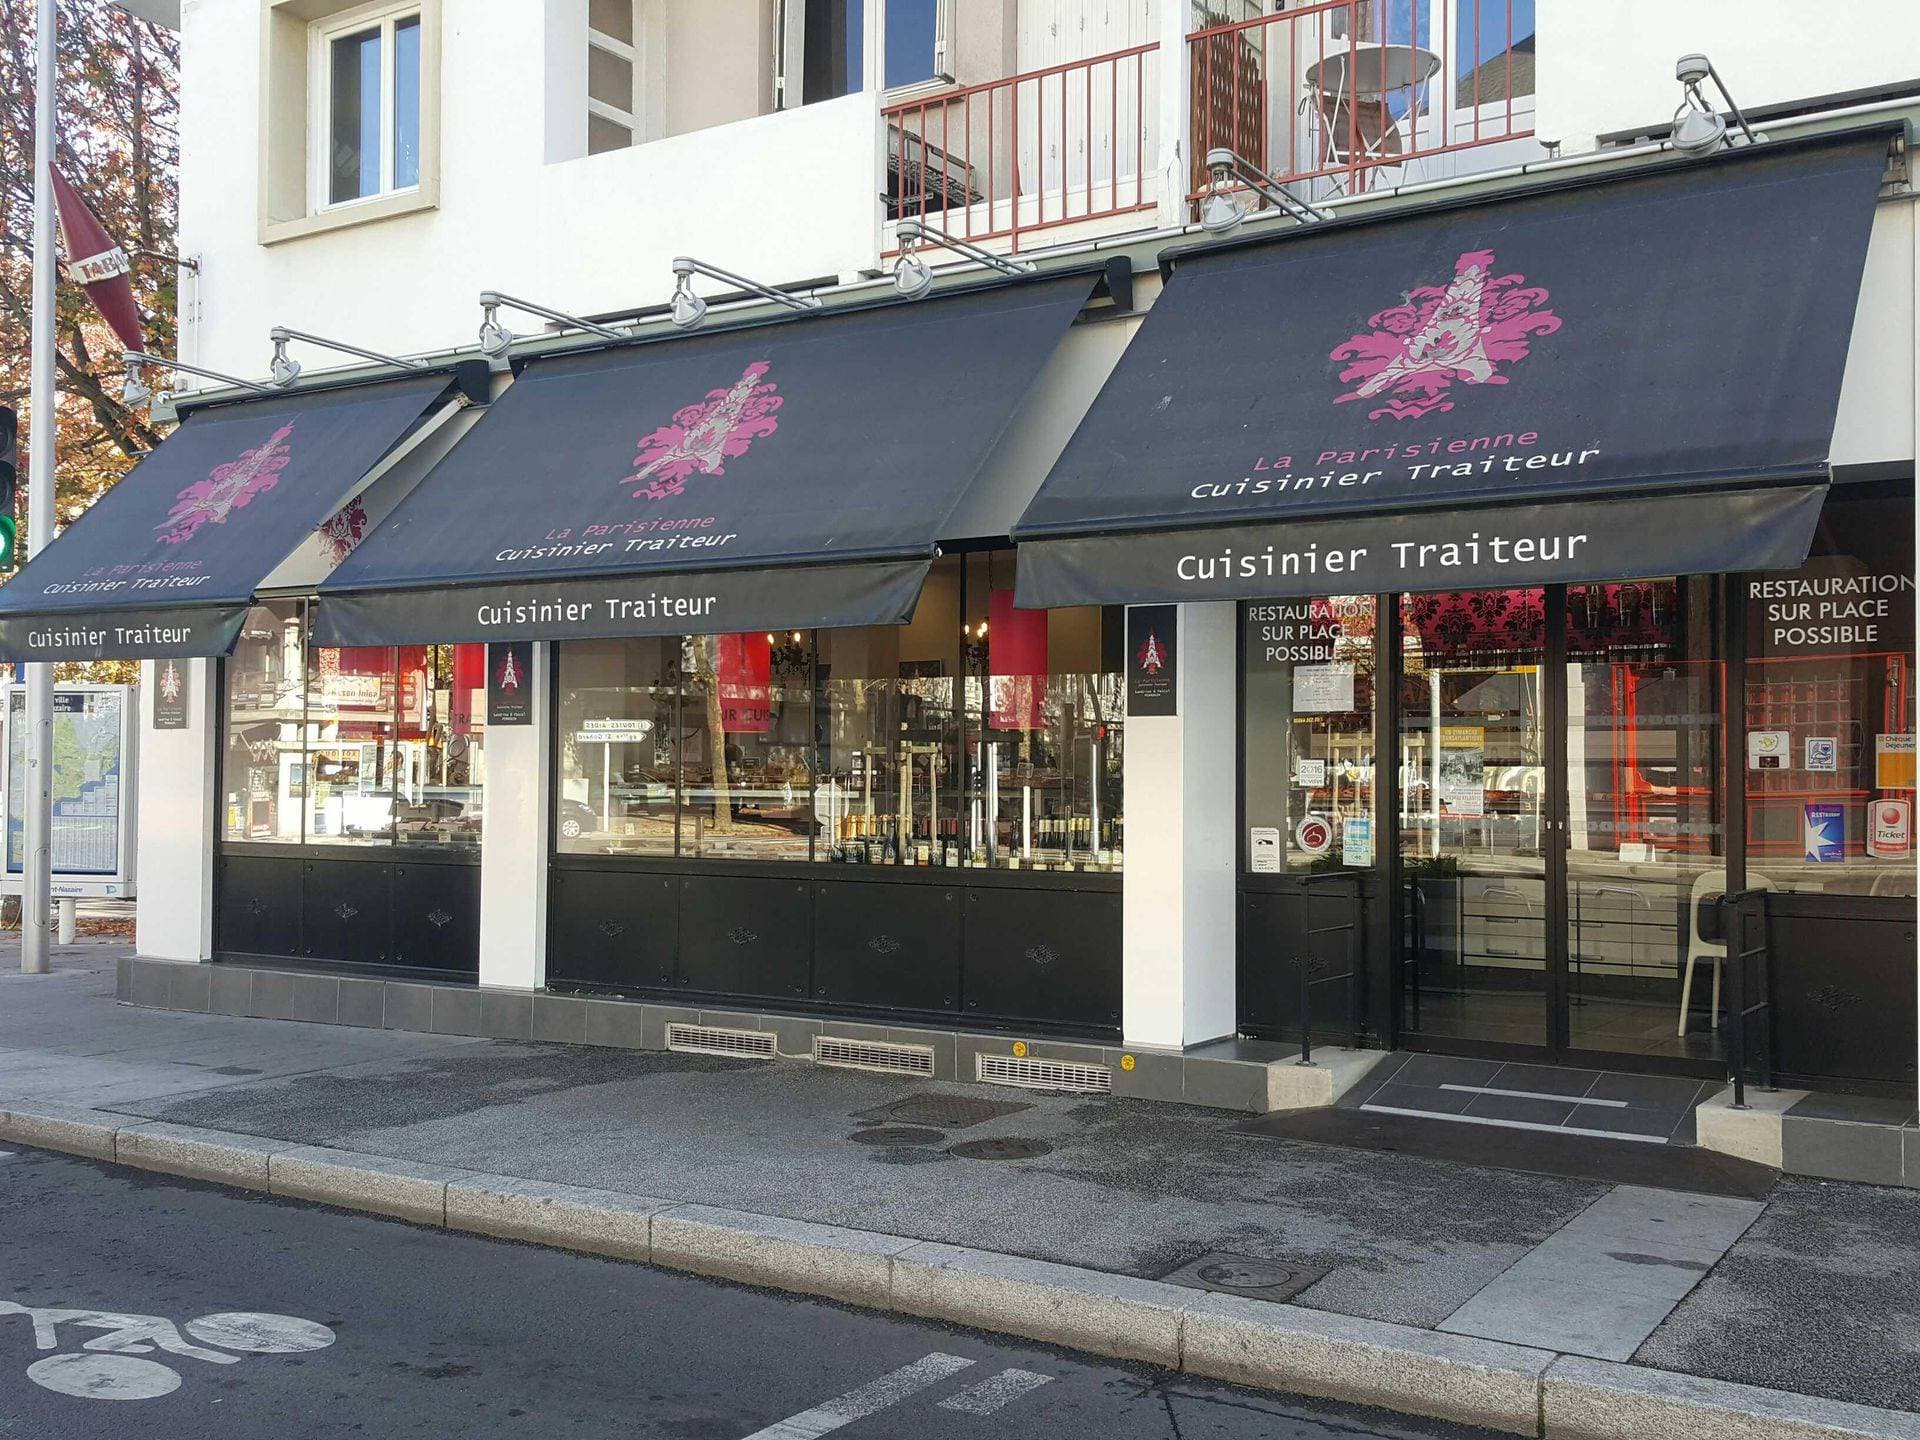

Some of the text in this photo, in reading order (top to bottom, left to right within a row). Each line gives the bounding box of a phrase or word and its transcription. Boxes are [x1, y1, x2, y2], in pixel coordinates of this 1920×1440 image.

[1253, 431, 1539, 471] La Parisienne
[1191, 448, 1600, 499] Cuisinier Traiteur
[545, 515, 716, 541] La Parisienne
[495, 532, 737, 562] Cuisinier Traiteur
[1176, 532, 1587, 581] Cuisinier Traiteur
[83, 559, 202, 577] La Parisienne
[43, 574, 212, 595] Cuisinier Traiteur
[1749, 574, 1916, 599] RESTAURATION
[477, 592, 717, 626] Cuisinier Traiteur
[1249, 602, 1373, 621] RESTAURATION
[1768, 599, 1888, 622] SUR PLACE
[28, 623, 191, 648] Cuisinier Traiteur
[1262, 624, 1350, 641] SUR PLACE
[1774, 625, 1878, 645] POSSIBLE
[1266, 645, 1342, 661] POSSIBLE
[55, 696, 70, 704] ville
[1301, 765, 1323, 774] 2016
[1877, 830, 1906, 839] Ticket
